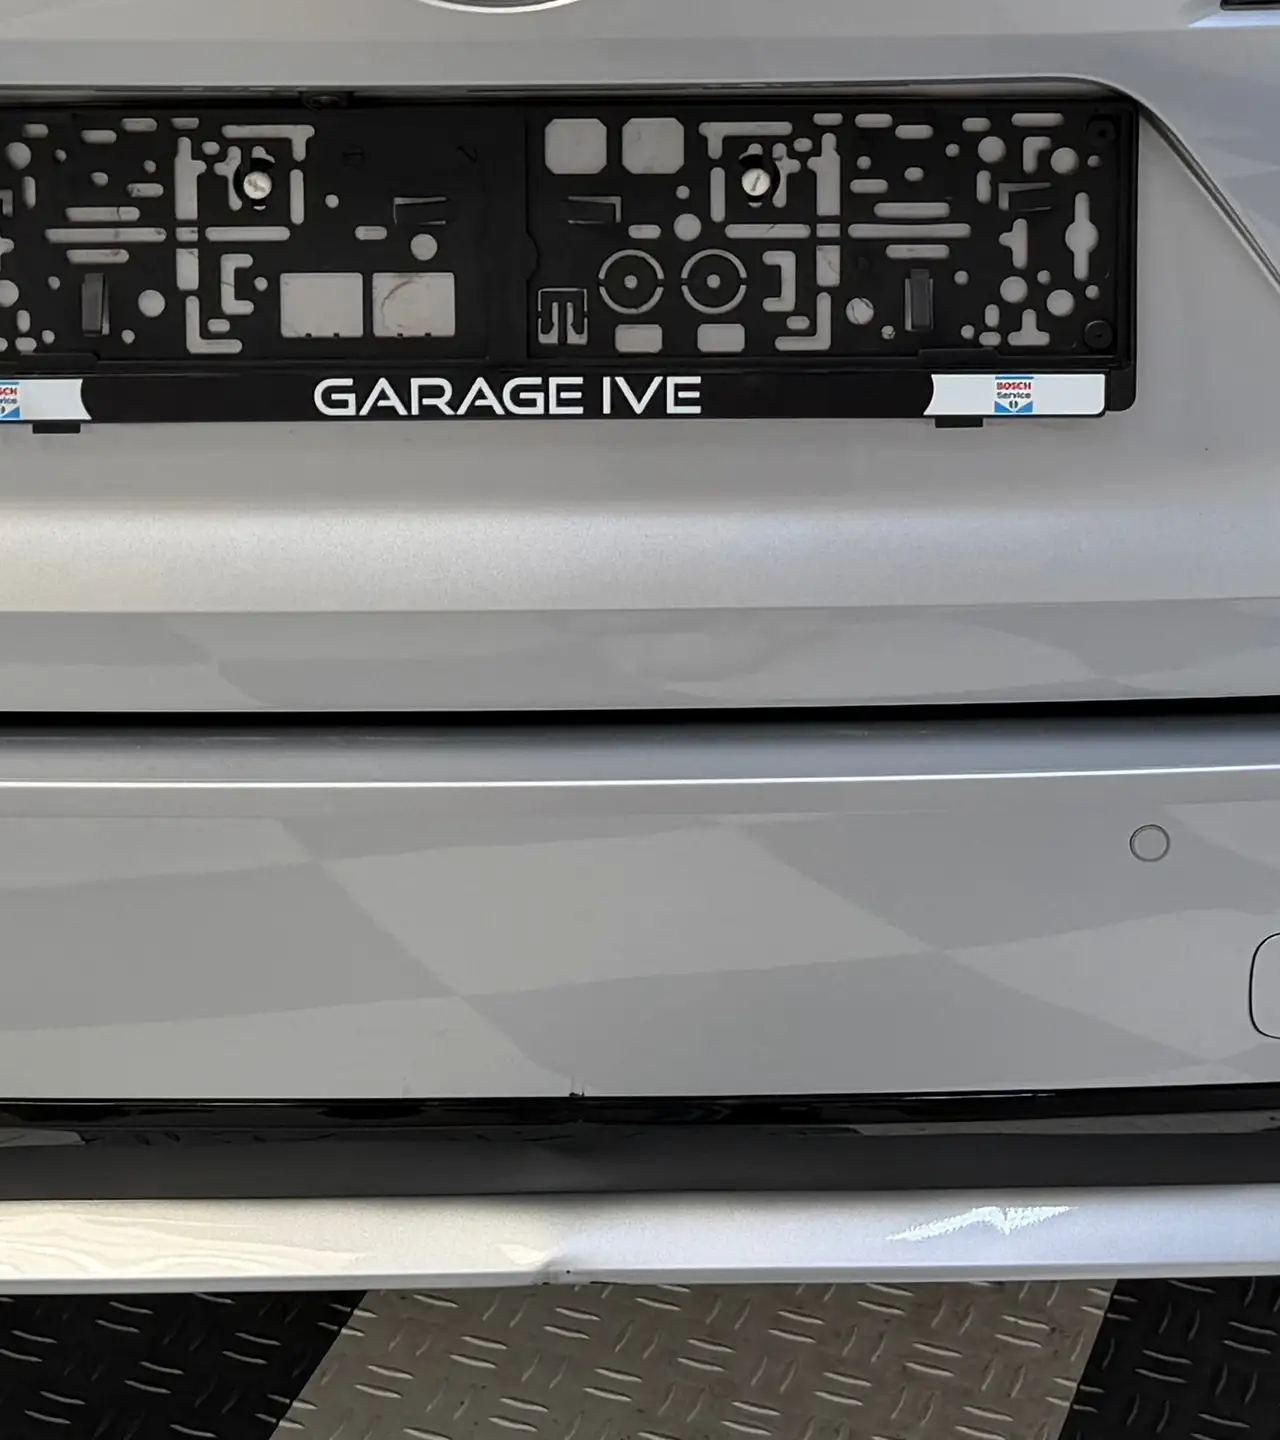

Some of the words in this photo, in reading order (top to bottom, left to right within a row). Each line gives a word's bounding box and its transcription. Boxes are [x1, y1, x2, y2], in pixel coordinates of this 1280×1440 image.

[314, 376, 584, 416] GARAGE
[602, 375, 702, 415] IVE
[996, 381, 1031, 390] BOSCH
